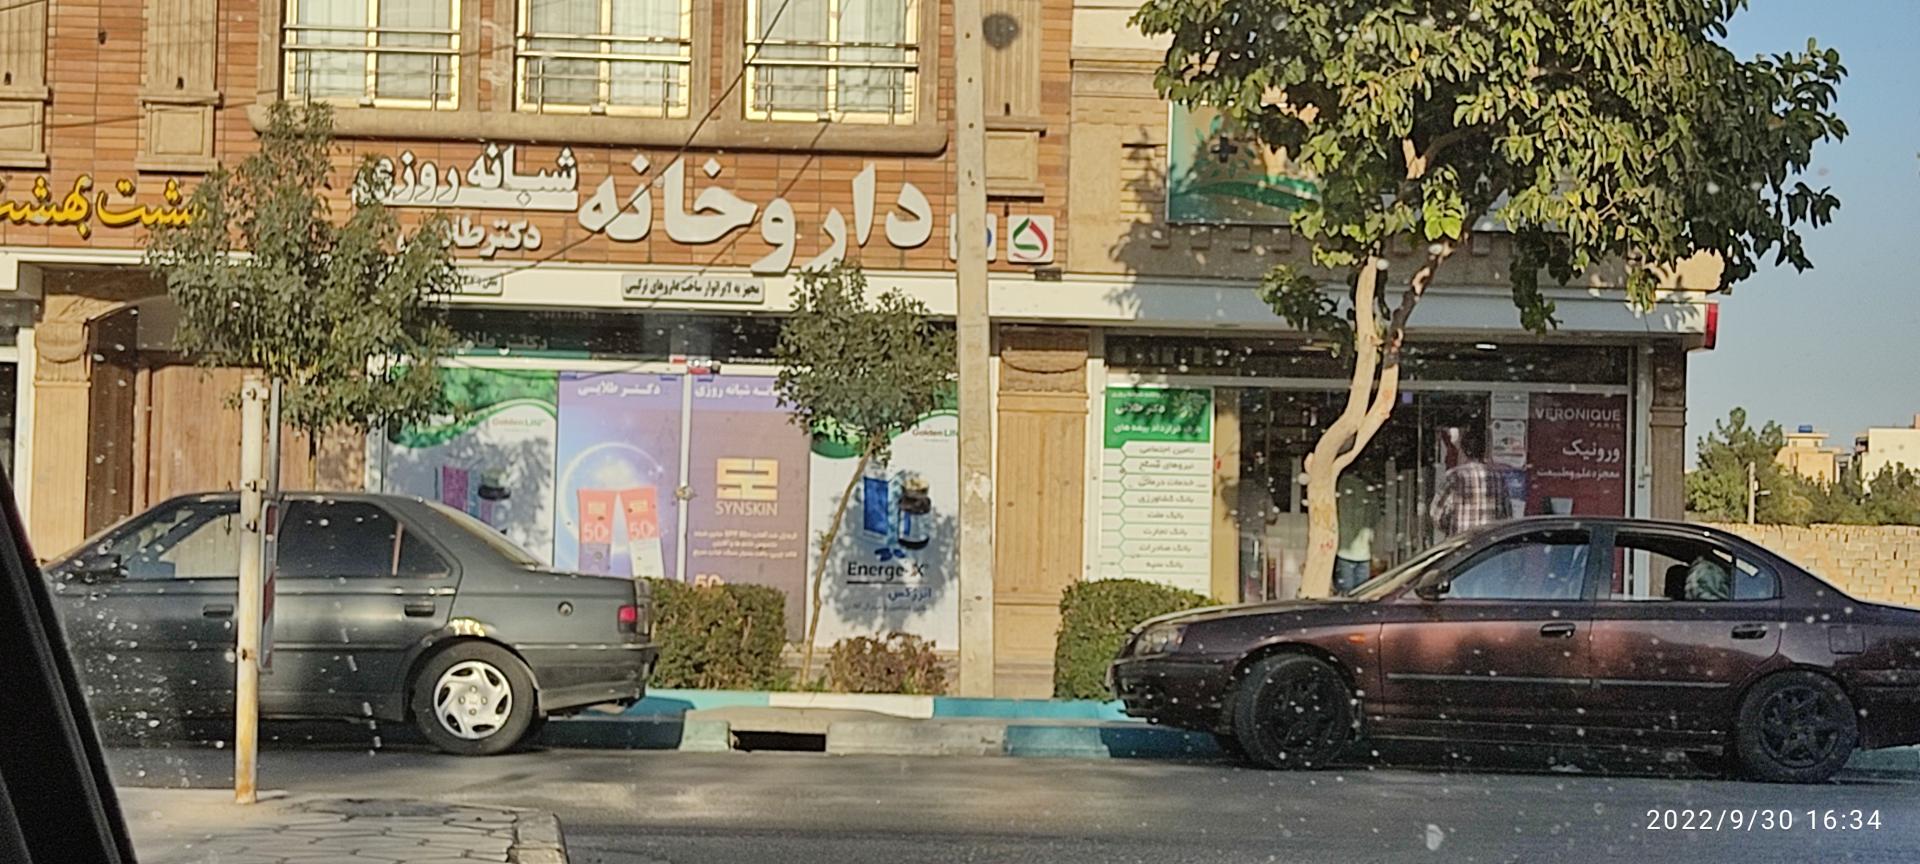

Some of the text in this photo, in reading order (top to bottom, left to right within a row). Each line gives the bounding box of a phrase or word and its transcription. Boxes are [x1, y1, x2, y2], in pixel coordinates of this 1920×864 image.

[467, 142, 578, 206] شبانه
[0, 174, 206, 240] شت بهش
[578, 154, 933, 275] داروخانه
[480, 218, 542, 258] دکتر
[620, 383, 661, 398] دکتر
[1535, 407, 1621, 421] VERONIQUE
[1562, 438, 1621, 463] ورونیک
[715, 501, 778, 516] SYNSKIN
